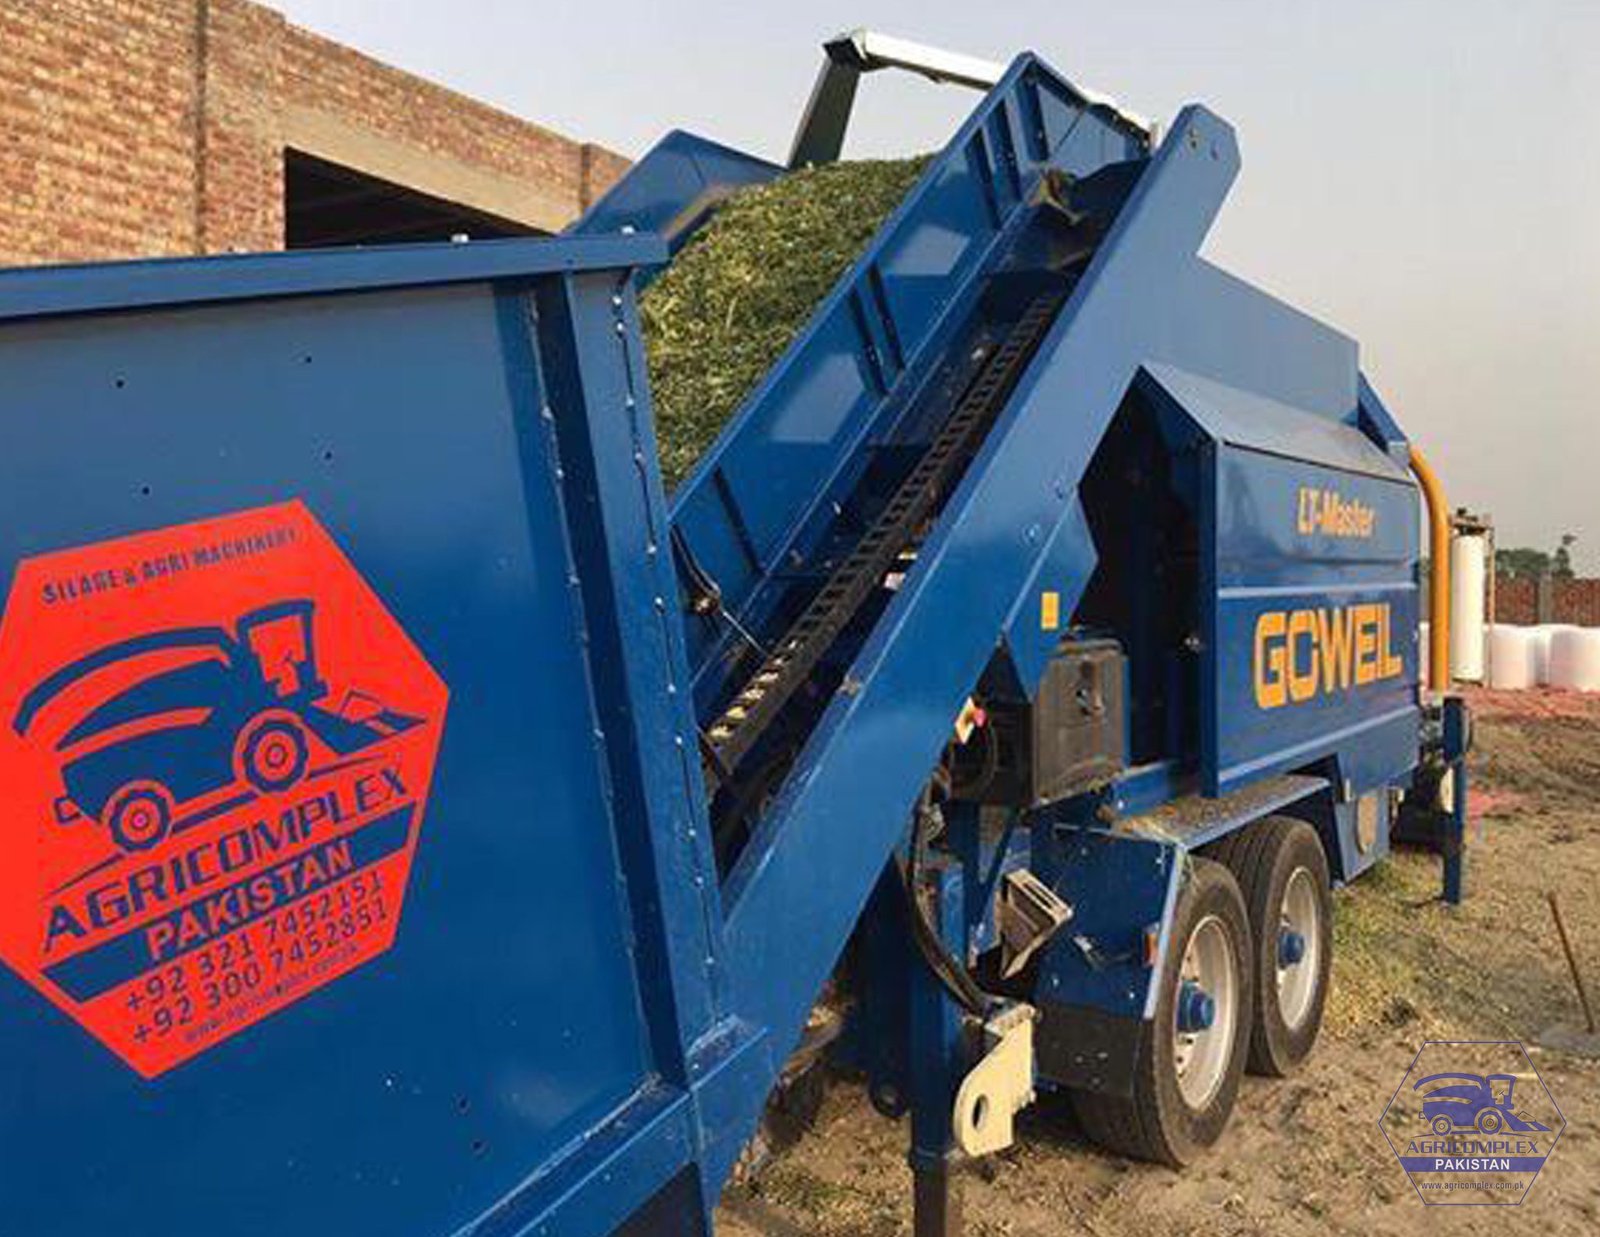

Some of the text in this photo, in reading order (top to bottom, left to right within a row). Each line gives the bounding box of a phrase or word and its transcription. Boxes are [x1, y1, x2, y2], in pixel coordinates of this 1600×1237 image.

[42, 568, 121, 605] SILAGE
[141, 552, 189, 579] AGRI
[42, 768, 406, 953] AGRICOMPLEX
[146, 841, 354, 962] PAKISTAN
[127, 968, 188, 1012] +92
[199, 930, 254, 976] 321
[264, 869, 385, 944] 7452151
[133, 999, 195, 1045] +92
[206, 961, 262, 1009] 300
